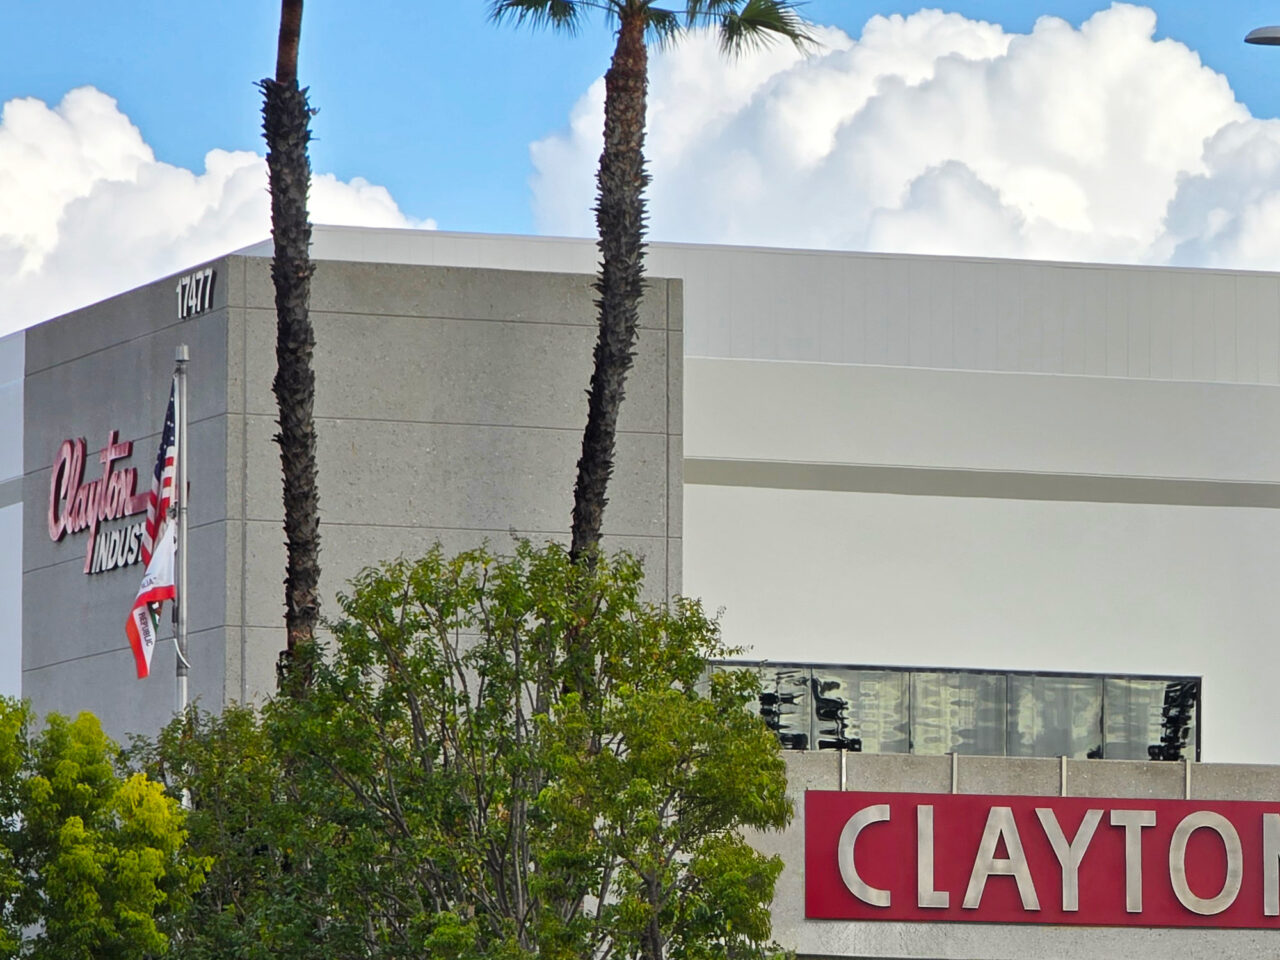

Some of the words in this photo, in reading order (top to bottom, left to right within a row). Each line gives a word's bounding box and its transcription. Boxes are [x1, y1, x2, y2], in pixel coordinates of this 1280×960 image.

[176, 268, 214, 319] 17477
[48, 430, 149, 574] Clayton
[91, 521, 147, 574] INDUST
